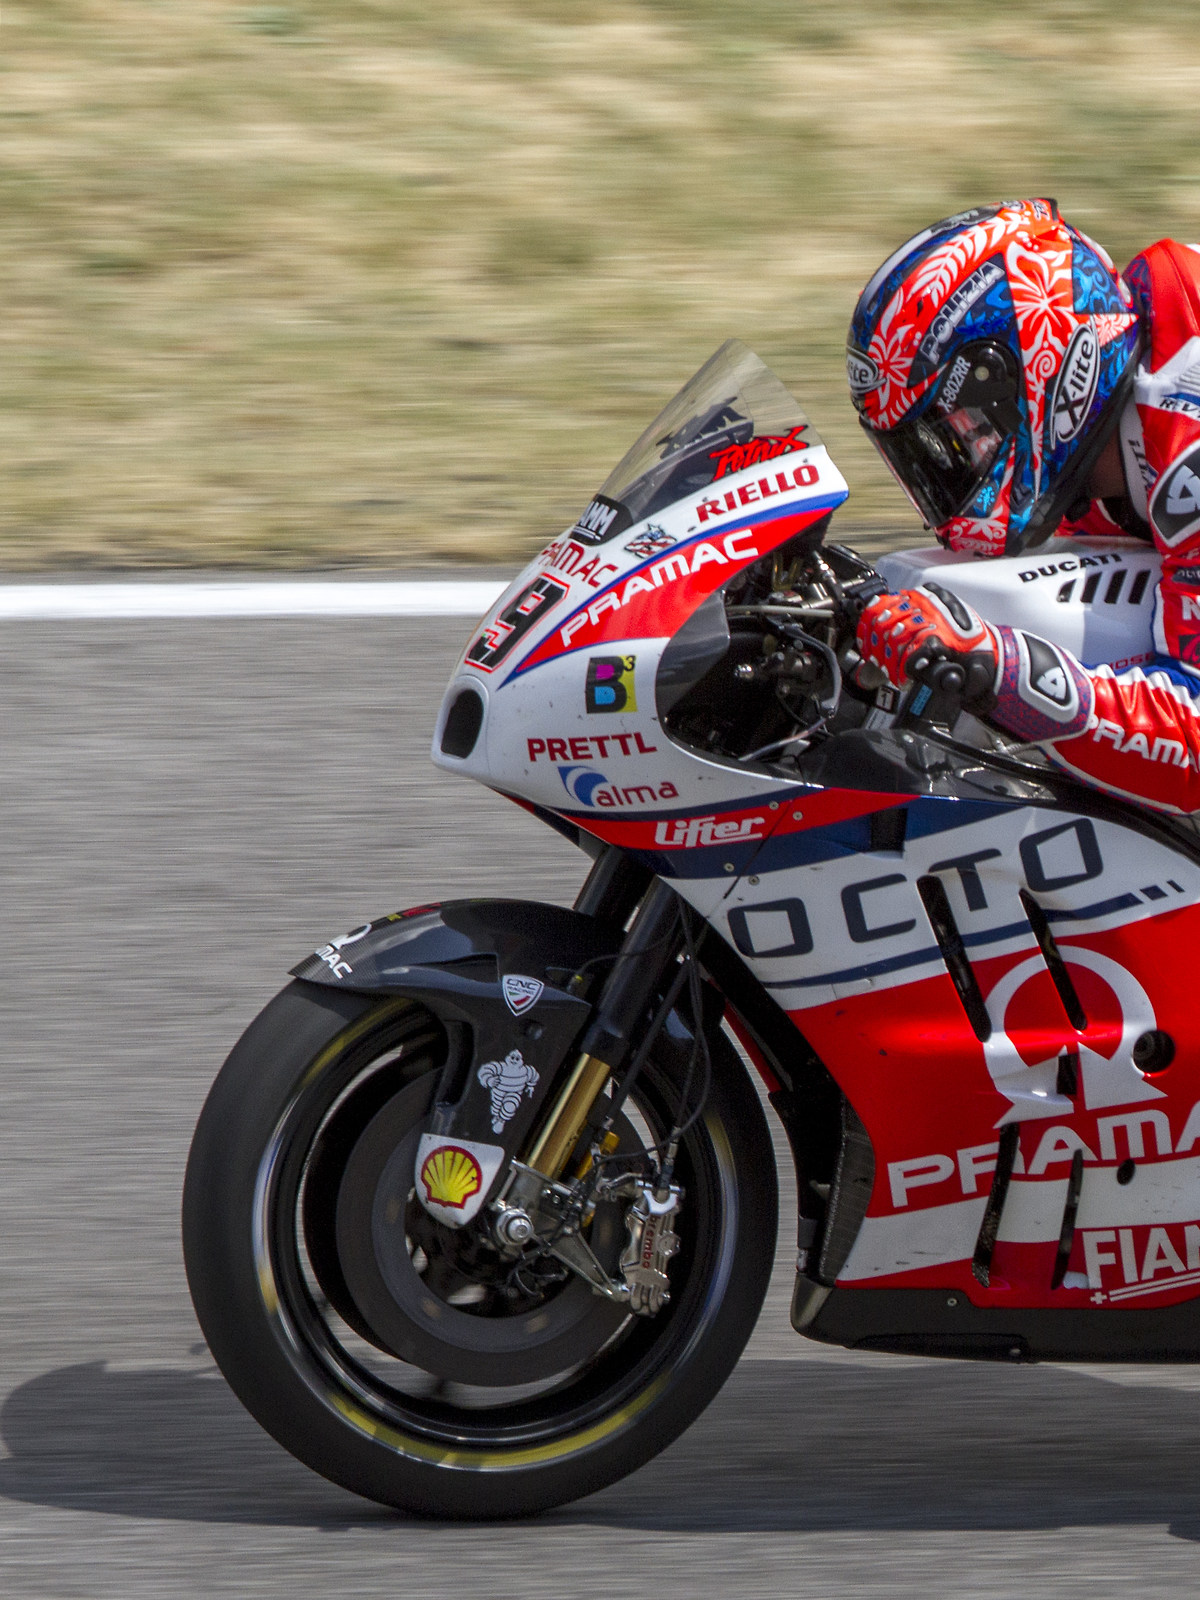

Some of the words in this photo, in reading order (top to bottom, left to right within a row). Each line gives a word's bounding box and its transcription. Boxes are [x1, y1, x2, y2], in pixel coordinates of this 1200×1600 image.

[1054, 340, 1093, 430] X-lite
[696, 464, 820, 523] RIELLO
[559, 529, 758, 648] PRAMAC
[1018, 552, 1122, 583] DUCATI
[527, 732, 657, 762] PRETTL
[596, 781, 679, 808] alma
[655, 816, 765, 848] Lifter
[727, 817, 1104, 959] OCTO
